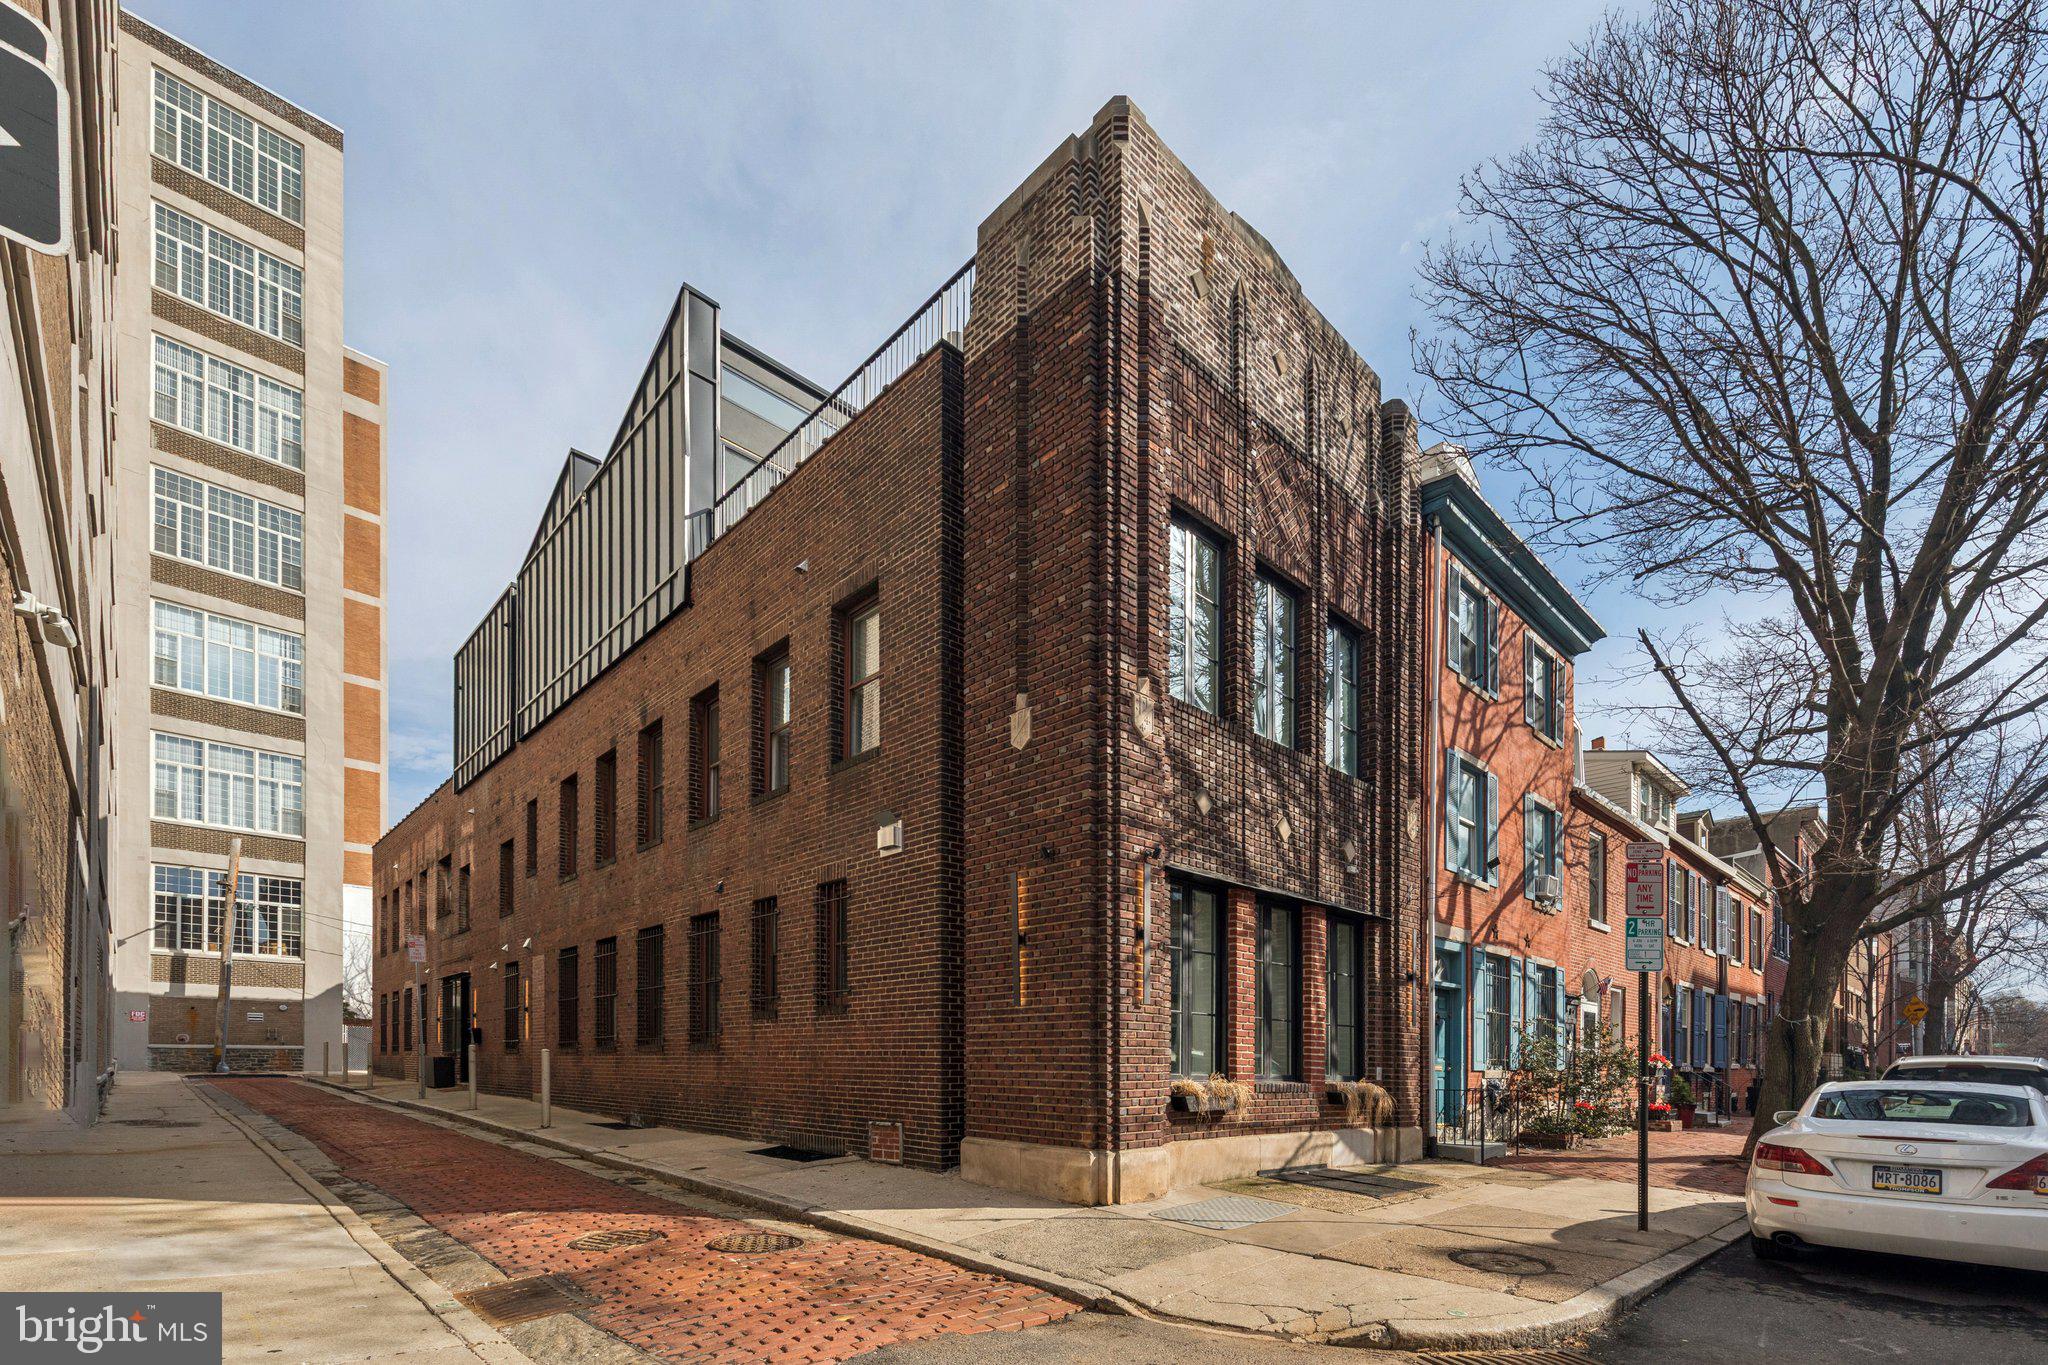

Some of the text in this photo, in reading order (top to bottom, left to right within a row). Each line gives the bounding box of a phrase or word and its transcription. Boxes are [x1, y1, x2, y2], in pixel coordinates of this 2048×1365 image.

[1627, 868, 1637, 878] NO
[1636, 884, 1653, 892] ANY
[1636, 894, 1654, 902] TIME
[1628, 919, 1655, 935] 2 HR
[1875, 1171, 1937, 1188] MRT-8086
